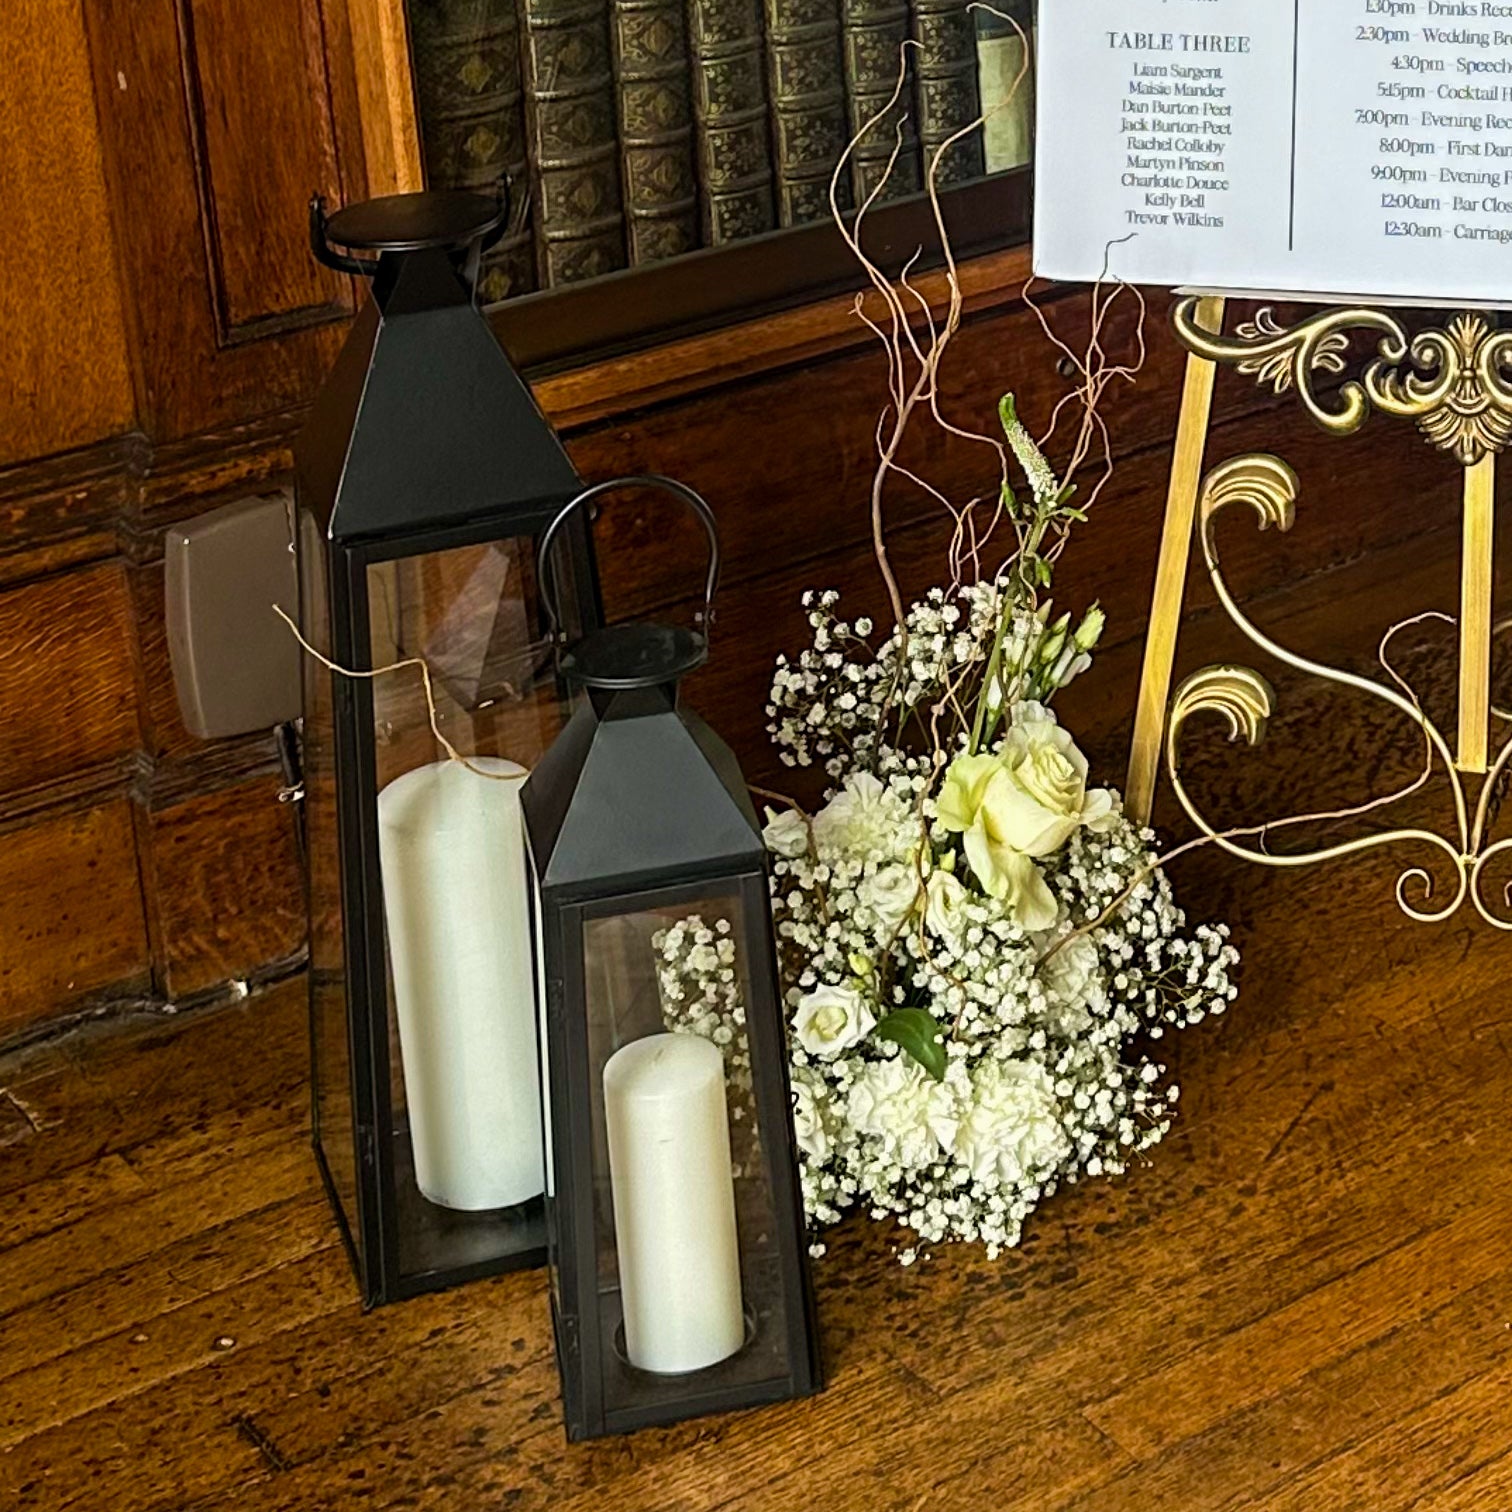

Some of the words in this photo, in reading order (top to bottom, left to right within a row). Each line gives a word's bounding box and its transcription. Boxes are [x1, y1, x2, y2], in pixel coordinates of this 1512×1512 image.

[1428, 0, 1477, 16] Drinks
[1106, 32, 1173, 51] TABLE
[1179, 34, 1250, 53] THREE
[1422, 28, 1490, 48] Wedding
[1170, 64, 1224, 81] Sargent
[1437, 84, 1498, 100] Cocktail
[1121, 99, 1149, 113] Dan
[1118, 117, 1150, 134] Jack
[1421, 111, 1482, 131] Evening
[1127, 136, 1173, 151] Rachel
[1448, 140, 1481, 156] First
[1126, 155, 1176, 172] Martyn
[1121, 173, 1184, 189] Charlotte
[1439, 168, 1501, 188] Evening
[1145, 193, 1177, 210] Kelly
[1180, 194, 1205, 208] Bell
[1452, 196, 1480, 212] Bar
[1172, 212, 1224, 227] Wilkins
